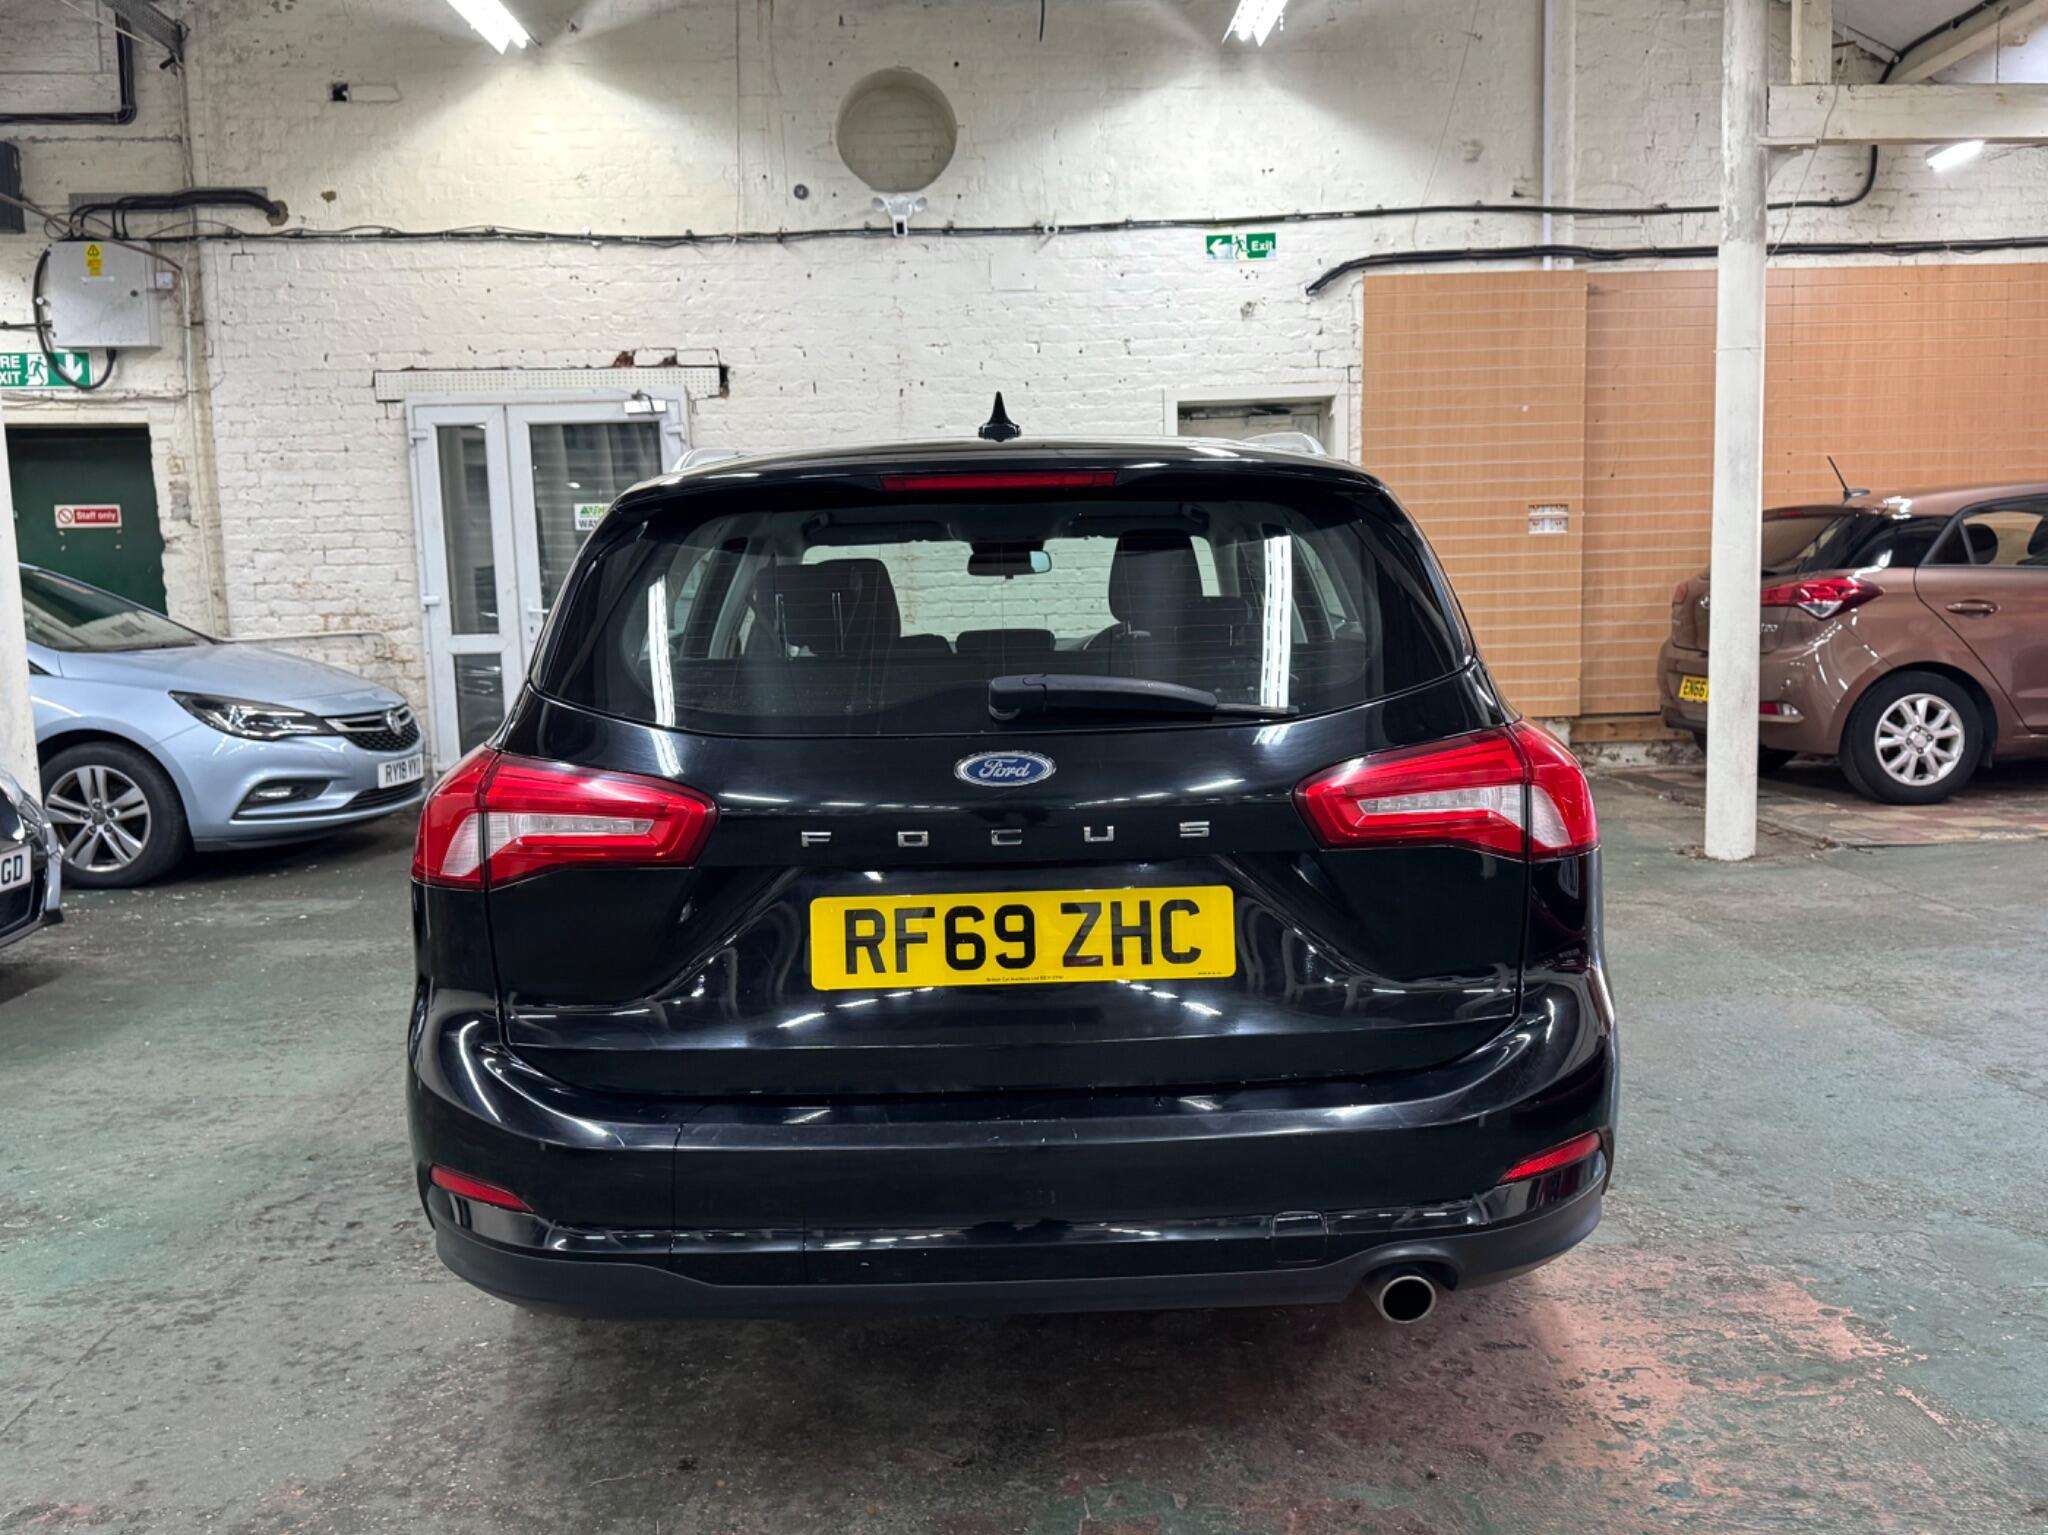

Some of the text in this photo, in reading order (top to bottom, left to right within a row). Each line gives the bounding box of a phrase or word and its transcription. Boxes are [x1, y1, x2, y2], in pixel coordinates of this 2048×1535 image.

[1251, 240, 1274, 251] Exit
[76, 510, 116, 521] Staff only
[979, 758, 1031, 778] Ford
[801, 821, 1210, 848] FOCUS
[1, 854, 23, 885] GD
[844, 898, 1202, 974] RF69 ZHC
